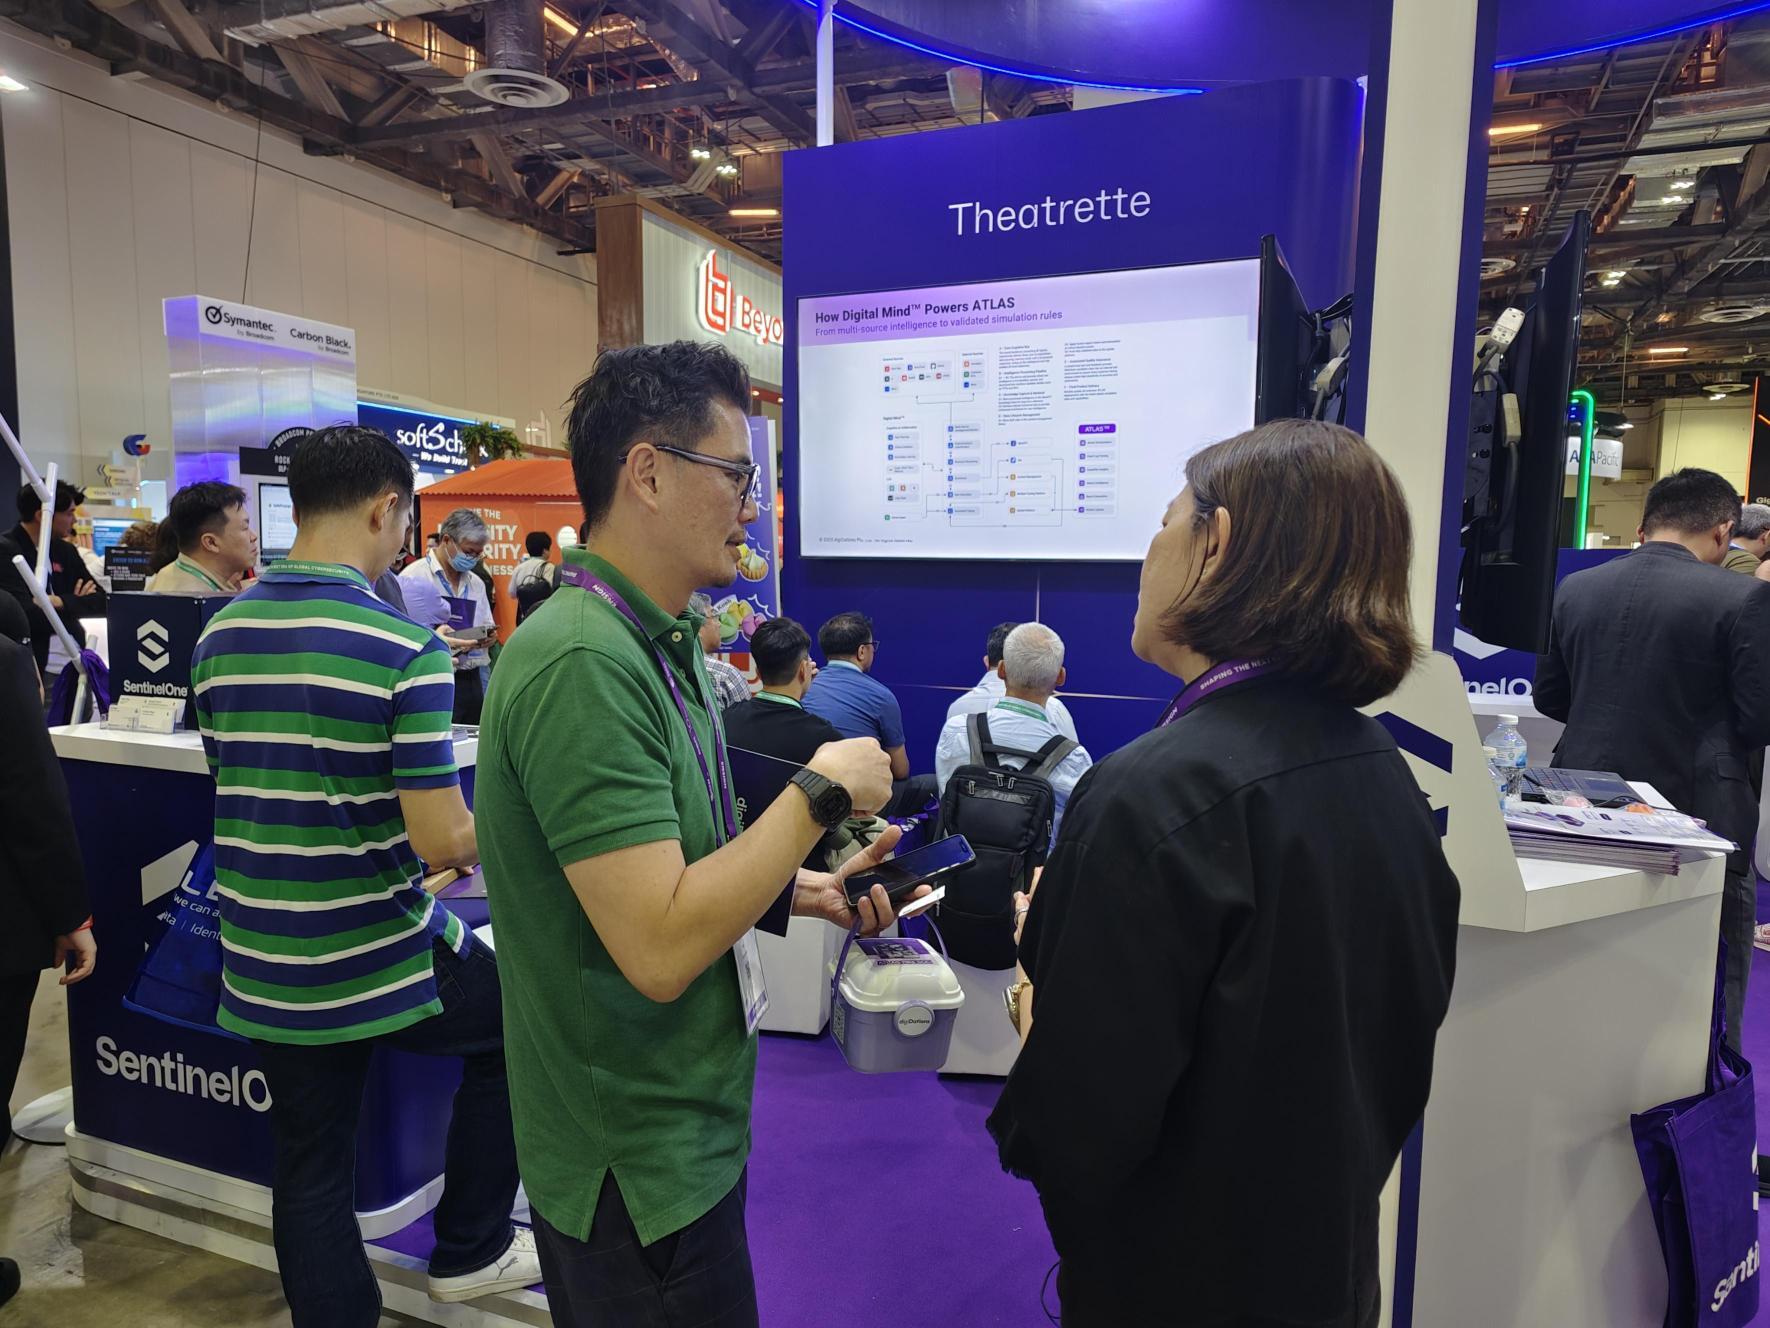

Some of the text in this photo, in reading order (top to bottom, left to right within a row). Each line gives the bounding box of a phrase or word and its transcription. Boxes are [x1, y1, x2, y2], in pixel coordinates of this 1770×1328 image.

[948, 187, 1151, 236] Theatrette
[736, 295, 783, 345] Beyo
[815, 312, 839, 323] How
[842, 307, 878, 323] Digital
[924, 303, 969, 315] Powers
[972, 297, 1015, 311] ATLAS
[815, 310, 1063, 336] From multi-source intelligence to validated simulation rules
[246, 330, 275, 341] Broadcom
[290, 327, 324, 344] Carbon
[484, 509, 502, 520] THE
[123, 680, 188, 697] SentinelOne
[1199, 669, 1233, 690] SHAPING
[1233, 662, 1250, 674] THE
[189, 903, 211, 916] can
[1711, 1240, 1760, 1312] Senti
